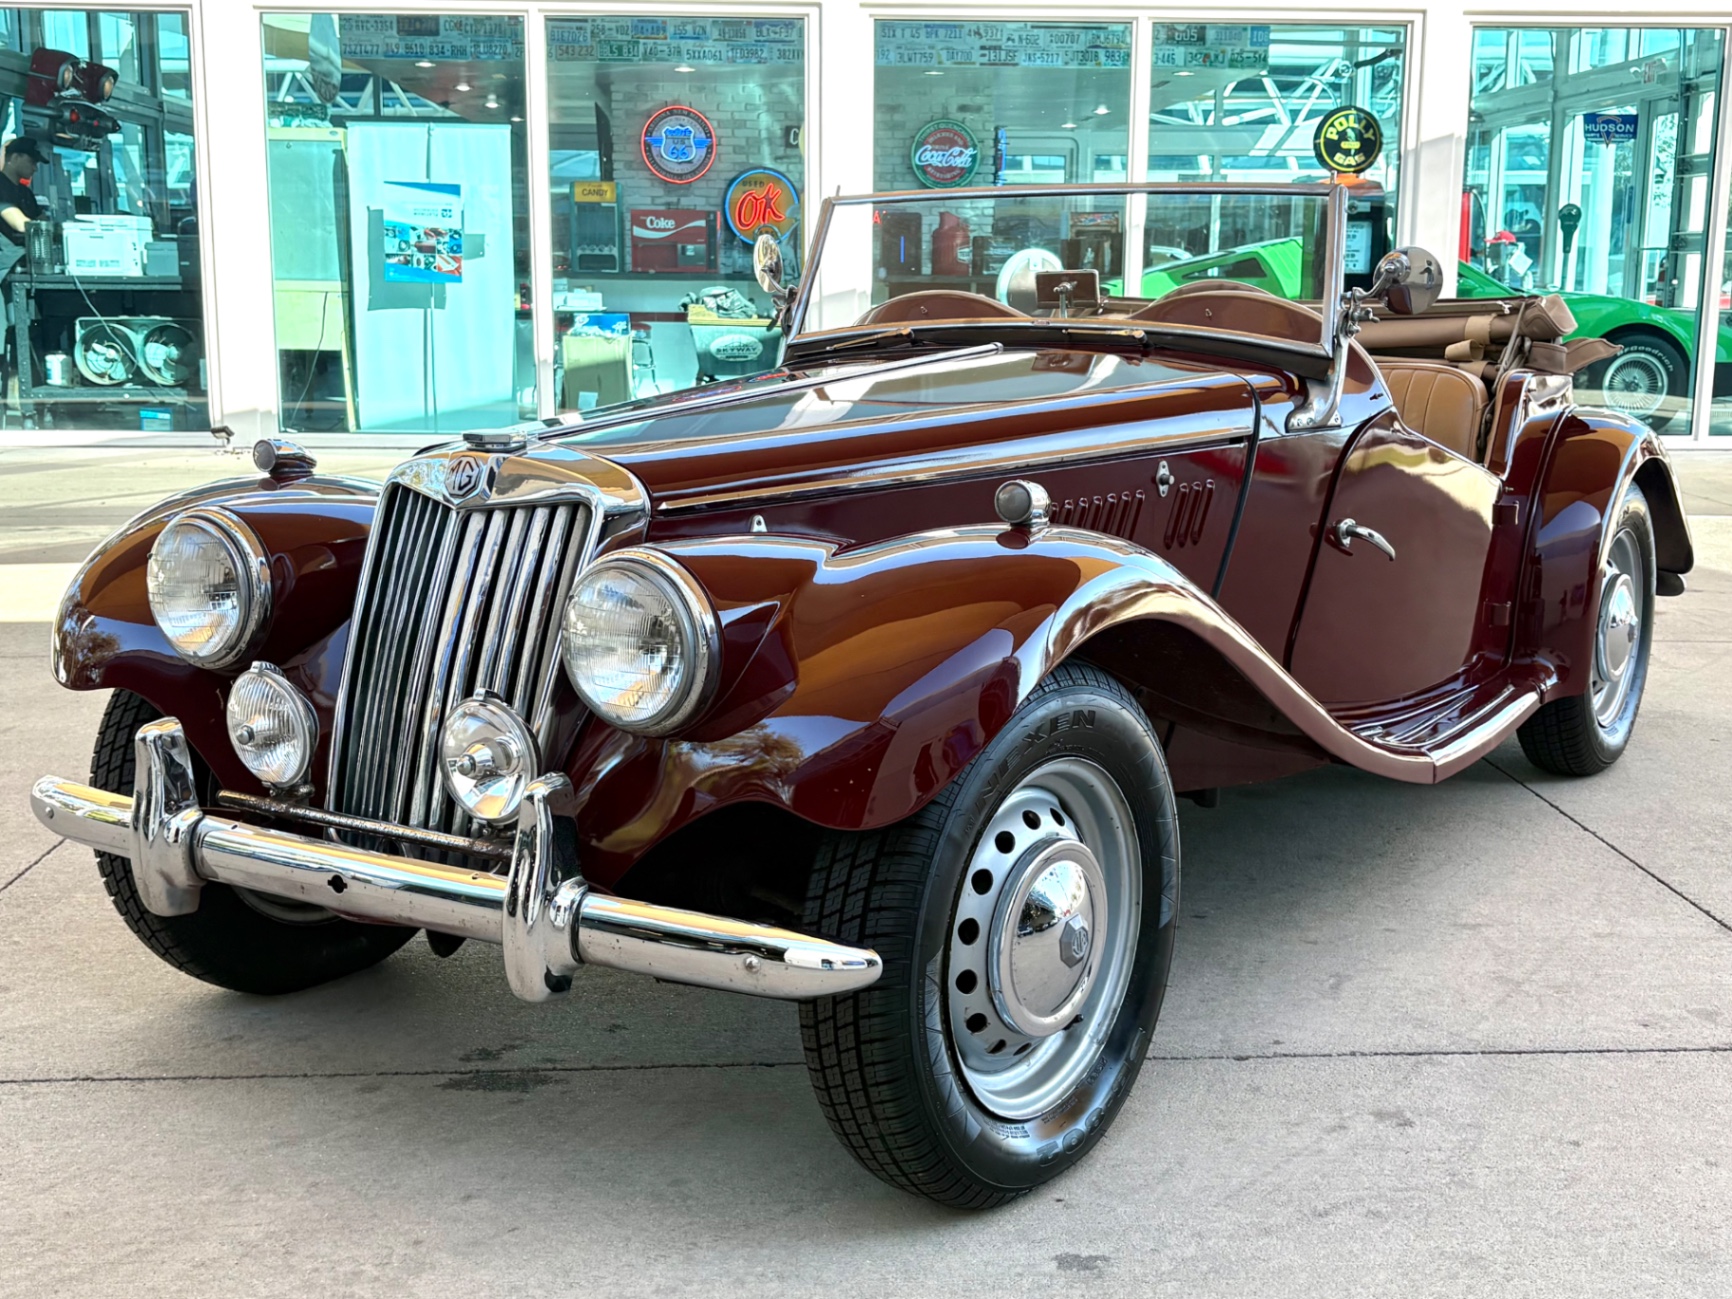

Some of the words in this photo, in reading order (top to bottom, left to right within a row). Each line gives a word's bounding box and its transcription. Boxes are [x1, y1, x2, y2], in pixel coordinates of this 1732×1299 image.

[1326, 114, 1375, 141] POLLY
[1585, 123, 1635, 133] HUDSON
[668, 145, 690, 159] 66
[1333, 152, 1366, 166] GAS
[581, 190, 609, 201] CANDY
[735, 182, 786, 230] OK
[645, 215, 676, 229] Coke
[716, 346, 758, 354] SKYWAY
[975, 709, 1096, 818] NEXEN
